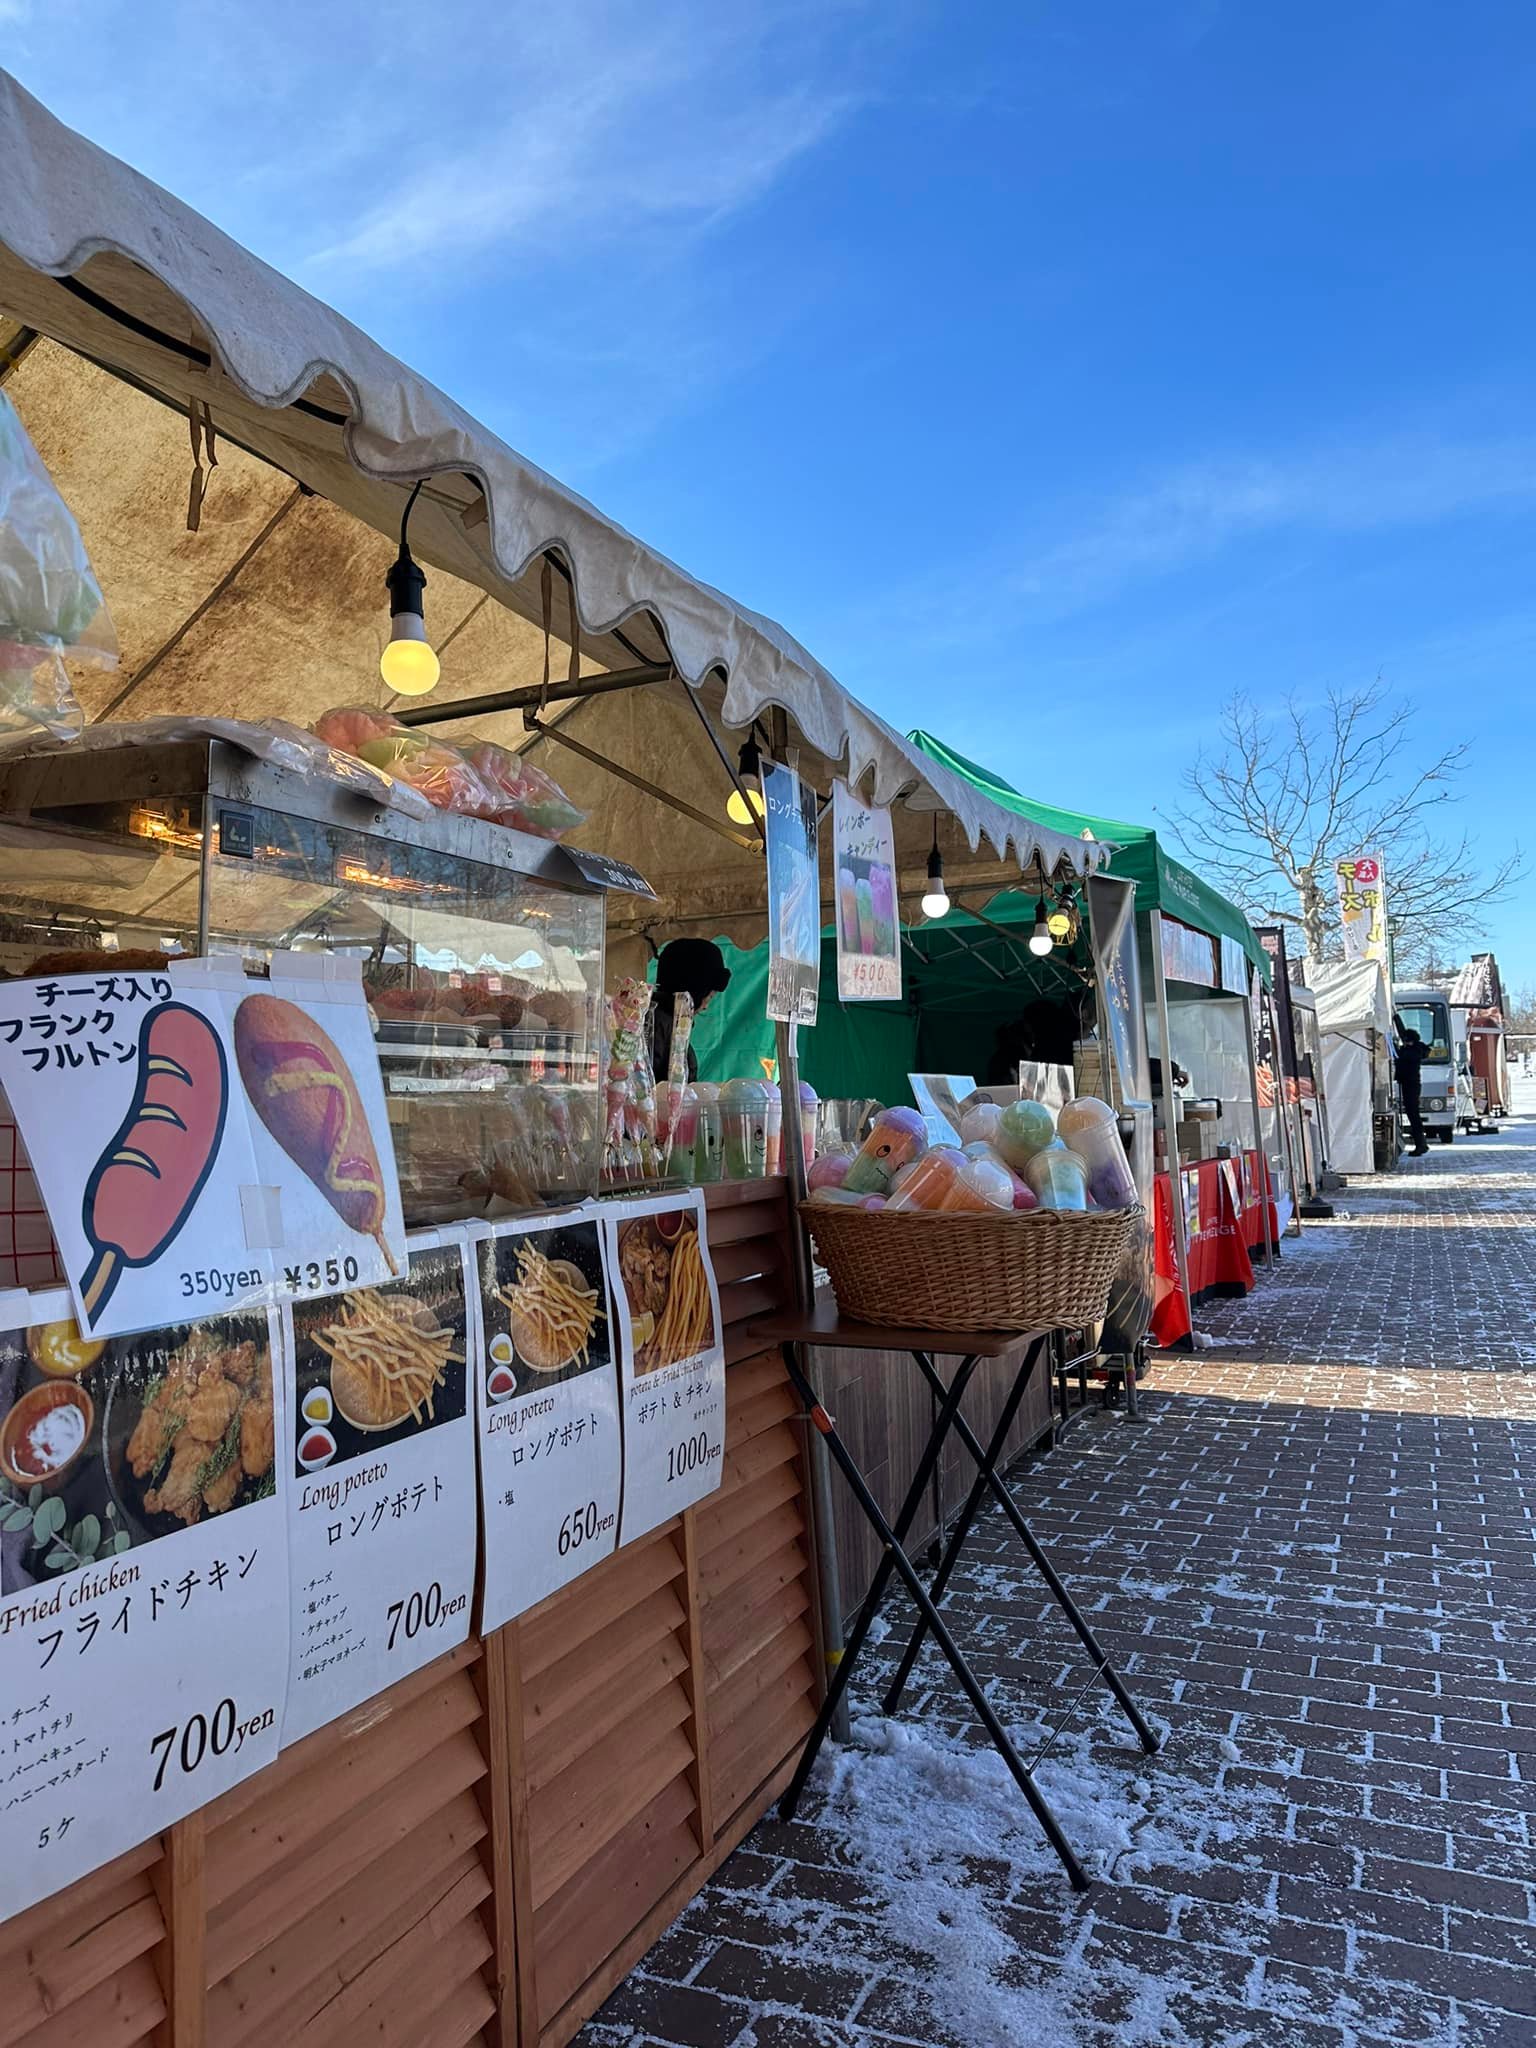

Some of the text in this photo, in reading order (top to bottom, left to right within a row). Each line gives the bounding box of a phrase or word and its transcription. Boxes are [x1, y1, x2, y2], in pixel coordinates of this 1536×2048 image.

[839, 811, 871, 833] レインボー
[35, 977, 173, 1007] チーズ入り
[0, 1009, 115, 1043] フランク
[22, 1041, 137, 1072] フルトン
[180, 1267, 263, 1297] 350yen
[283, 1255, 359, 1294] ¥350
[487, 1396, 555, 1435] Long poteto
[638, 1379, 713, 1425] ポテト & チキン
[512, 1413, 598, 1467] ロングポテト
[667, 1431, 721, 1483] 1000yen
[299, 1462, 388, 1511] Long poteto
[327, 1475, 443, 1546] ロングポテト
[558, 1501, 615, 1556] 650yen
[0, 1561, 142, 1636] Fried chicken
[37, 1548, 258, 1669] フライドチキン
[386, 1581, 466, 1651] 700yen
[150, 1697, 275, 1792] 700yen
